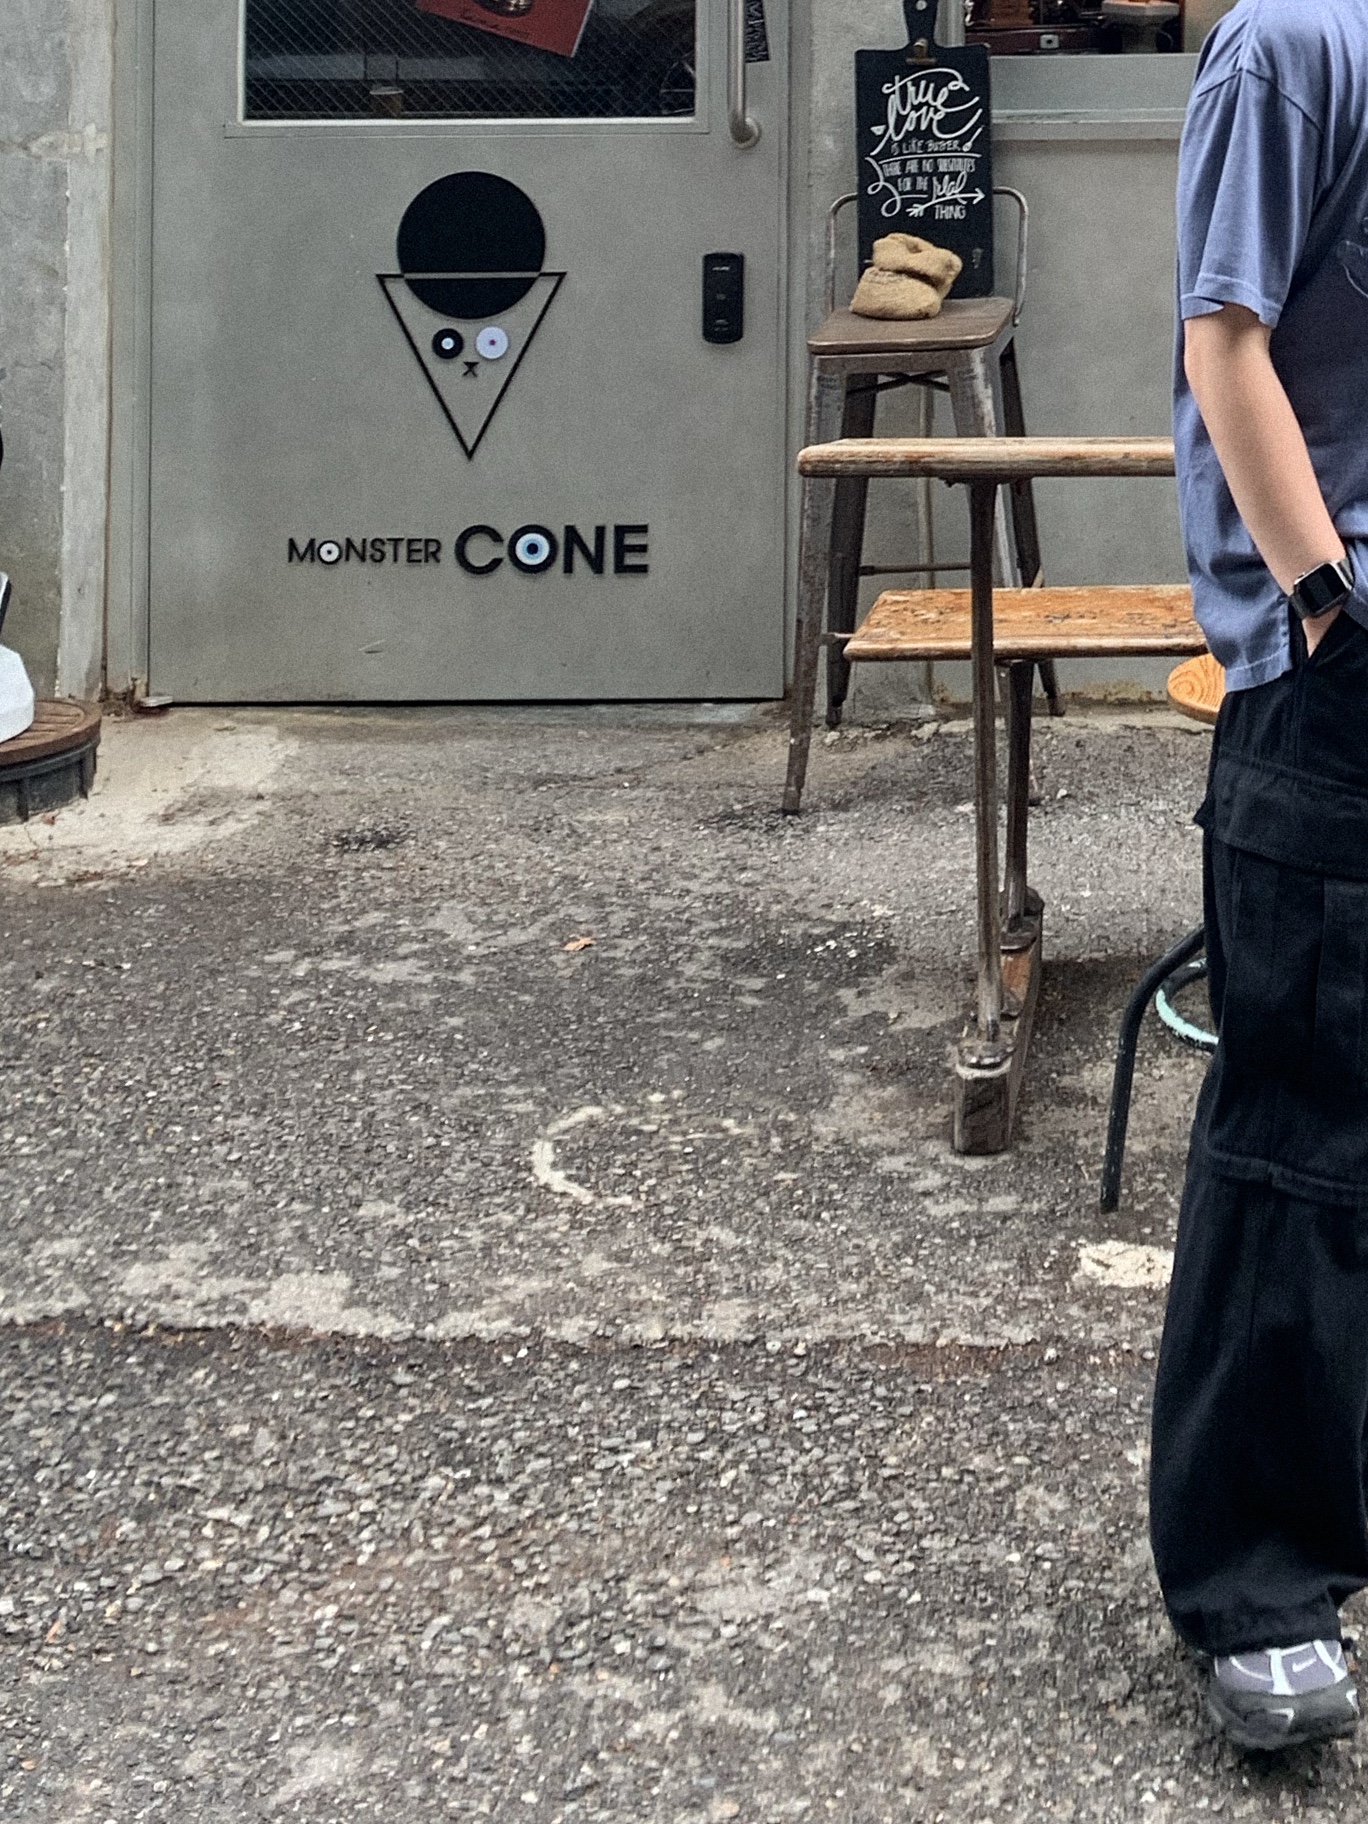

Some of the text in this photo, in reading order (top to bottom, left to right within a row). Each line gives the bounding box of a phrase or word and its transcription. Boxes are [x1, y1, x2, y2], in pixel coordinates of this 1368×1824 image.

[934, 205, 967, 220] THING
[287, 523, 650, 575] MONSTER CONE
